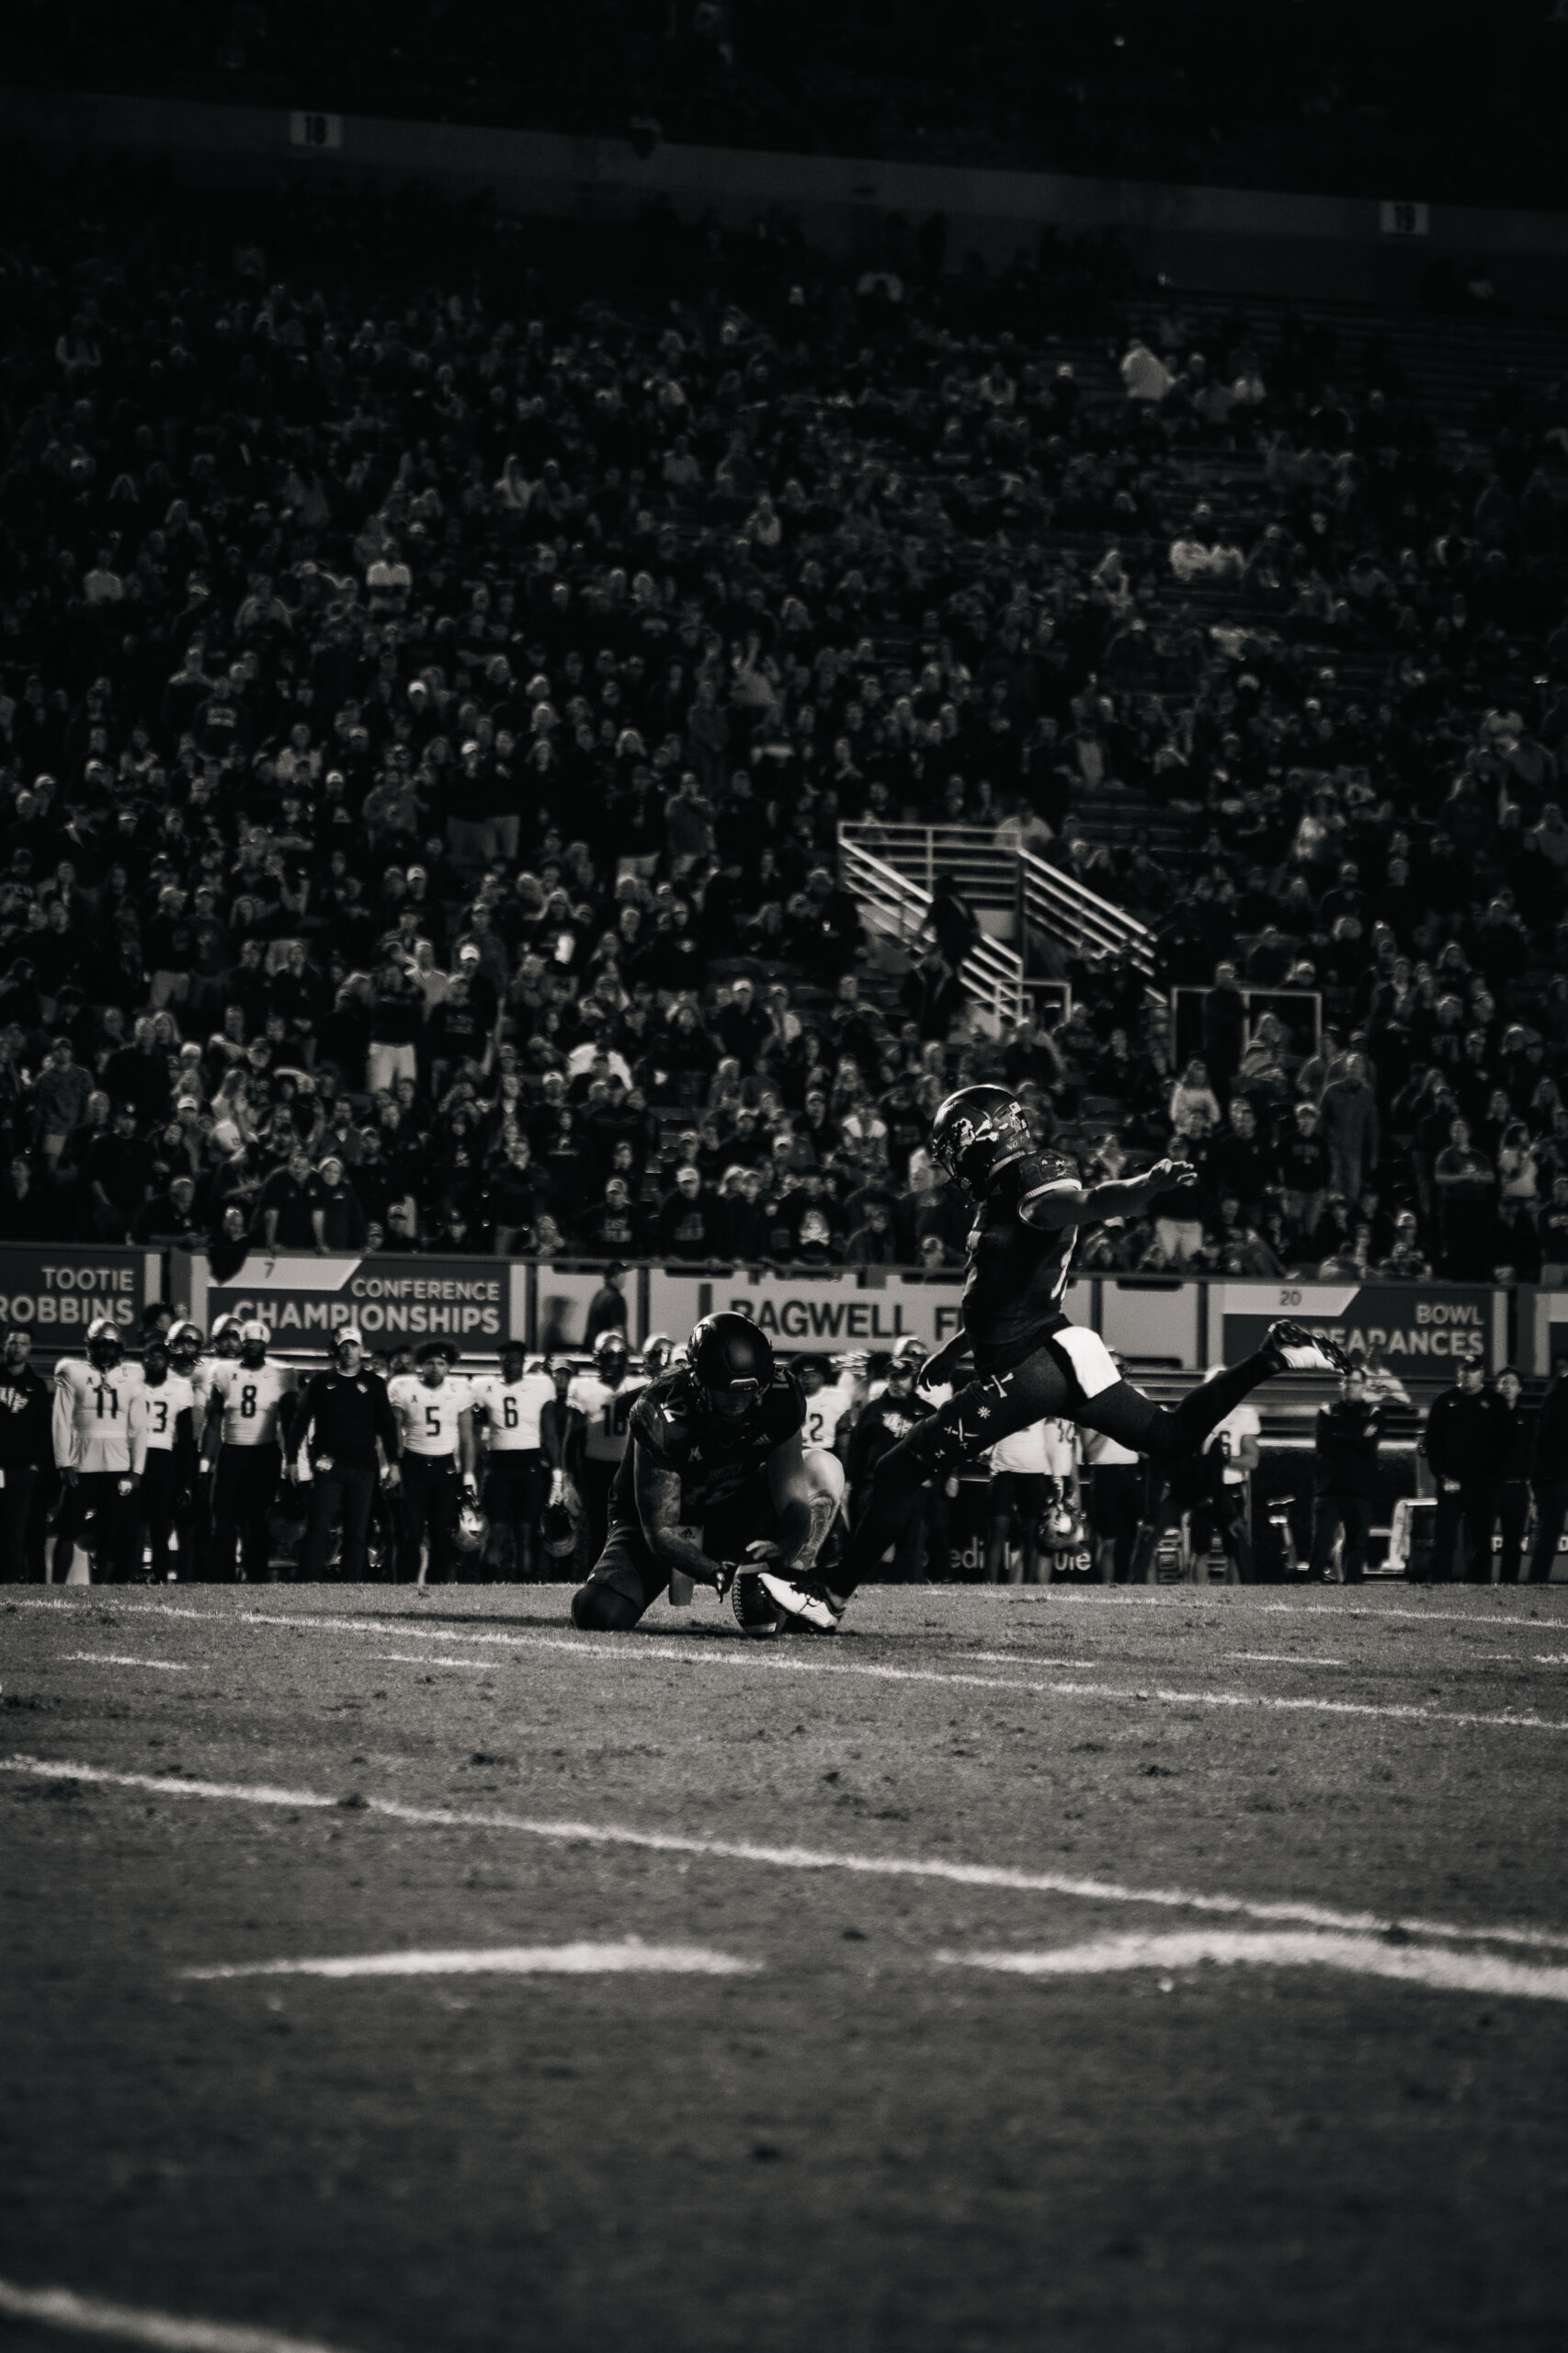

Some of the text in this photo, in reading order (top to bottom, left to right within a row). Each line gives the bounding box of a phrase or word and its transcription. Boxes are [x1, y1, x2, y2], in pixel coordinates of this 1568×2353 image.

[40, 1266, 135, 1291] TOOTIE
[264, 1262, 274, 1278] 7
[351, 1277, 501, 1302] CONFERENCE
[1279, 1290, 1301, 1306] 20
[232, 1300, 501, 1335] CHAMPIONSHIPS
[1415, 1303, 1484, 1325] BOWL
[93, 1386, 118, 1419] 11
[241, 1385, 257, 1418] 8
[504, 1396, 519, 1428] 6
[425, 1406, 440, 1437] 5
